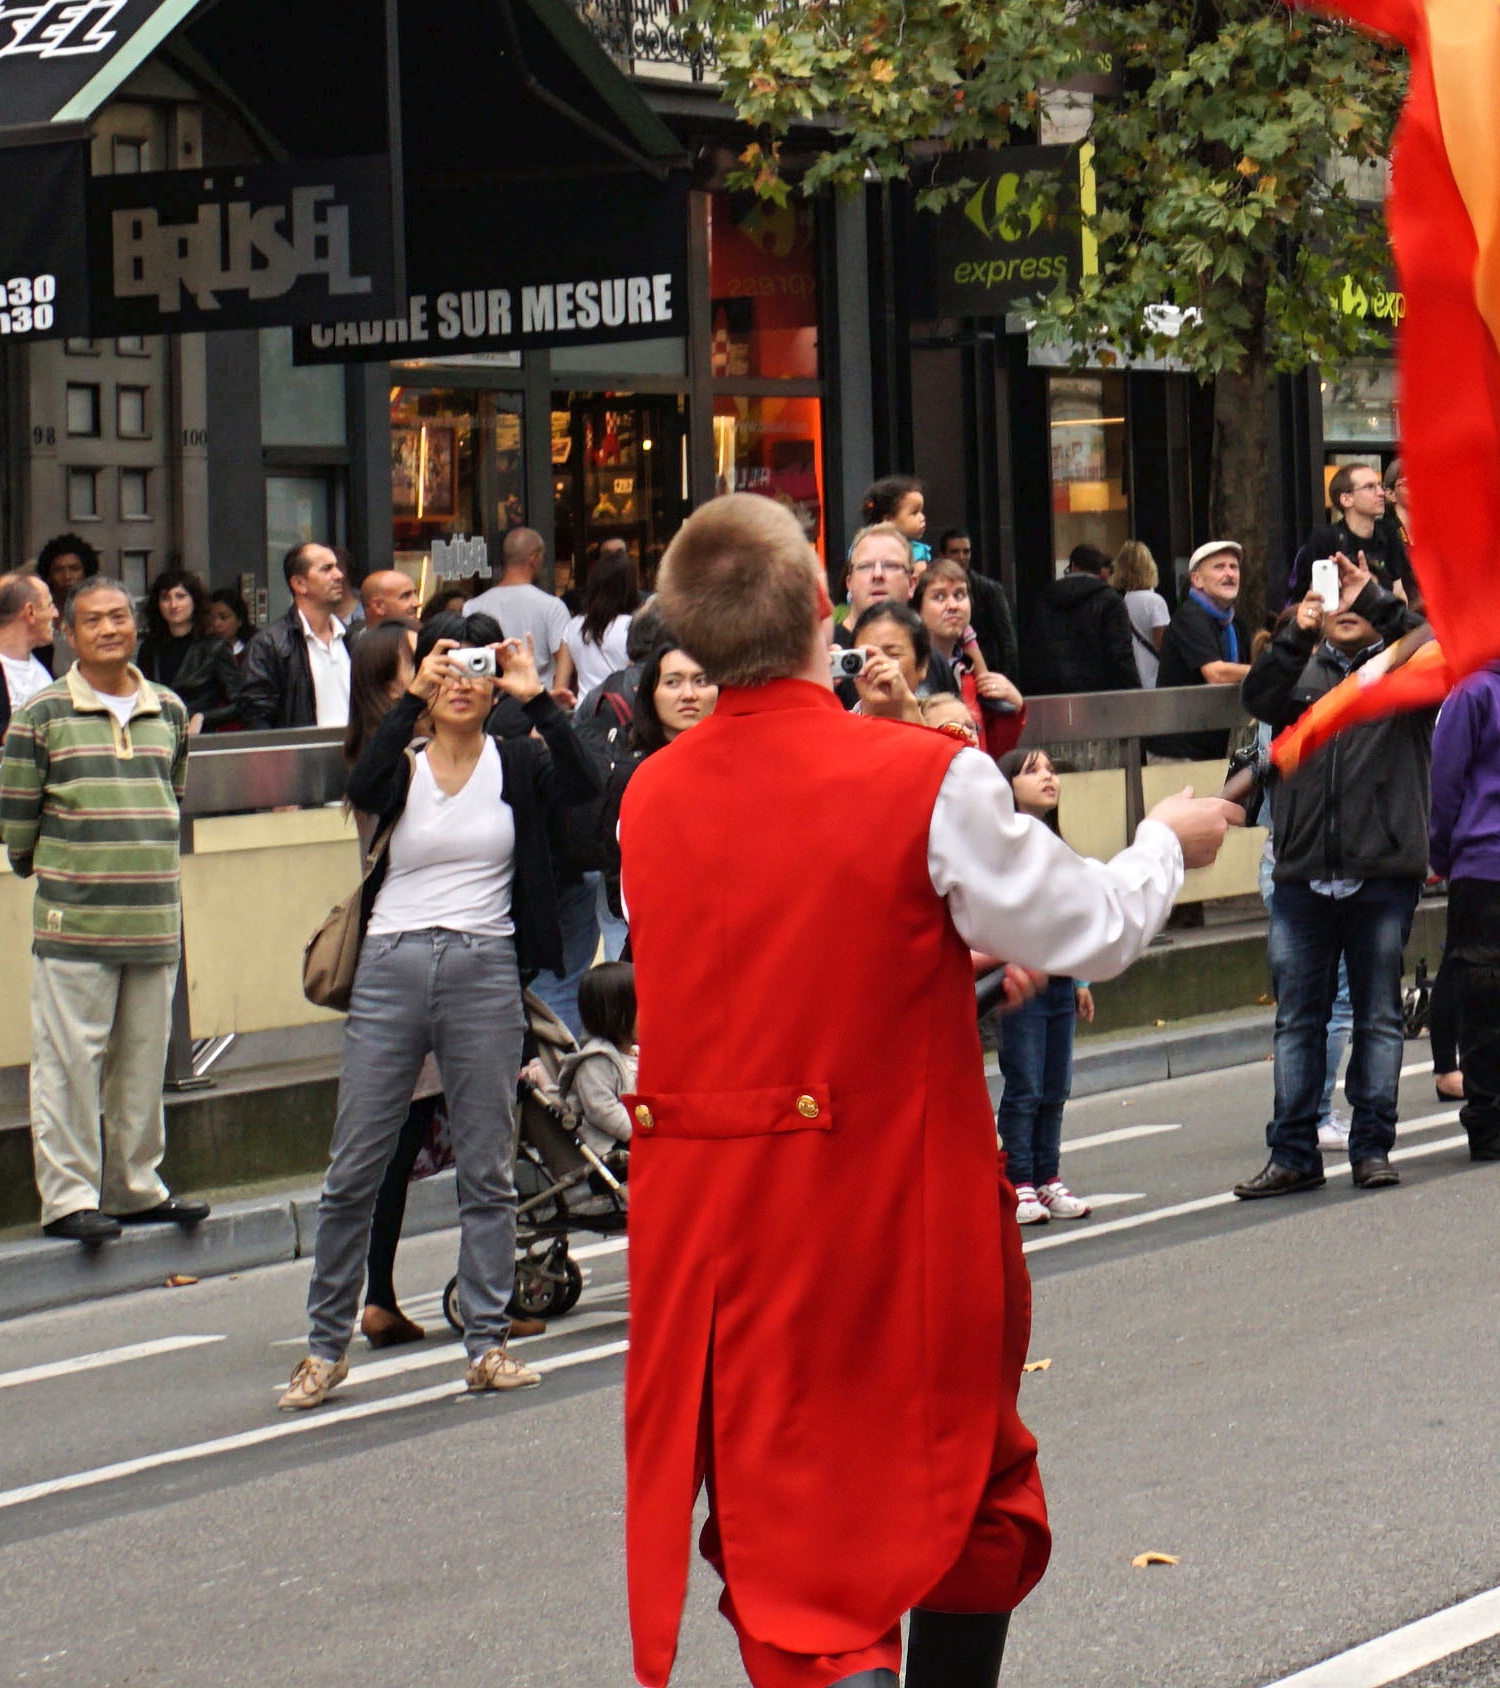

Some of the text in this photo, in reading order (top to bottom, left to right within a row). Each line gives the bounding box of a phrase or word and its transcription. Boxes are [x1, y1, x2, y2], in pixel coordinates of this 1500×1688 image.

[954, 255, 1068, 289] express
[437, 288, 513, 339] SUR
[521, 273, 673, 333] MESURE
[182, 428, 208, 447] 100
